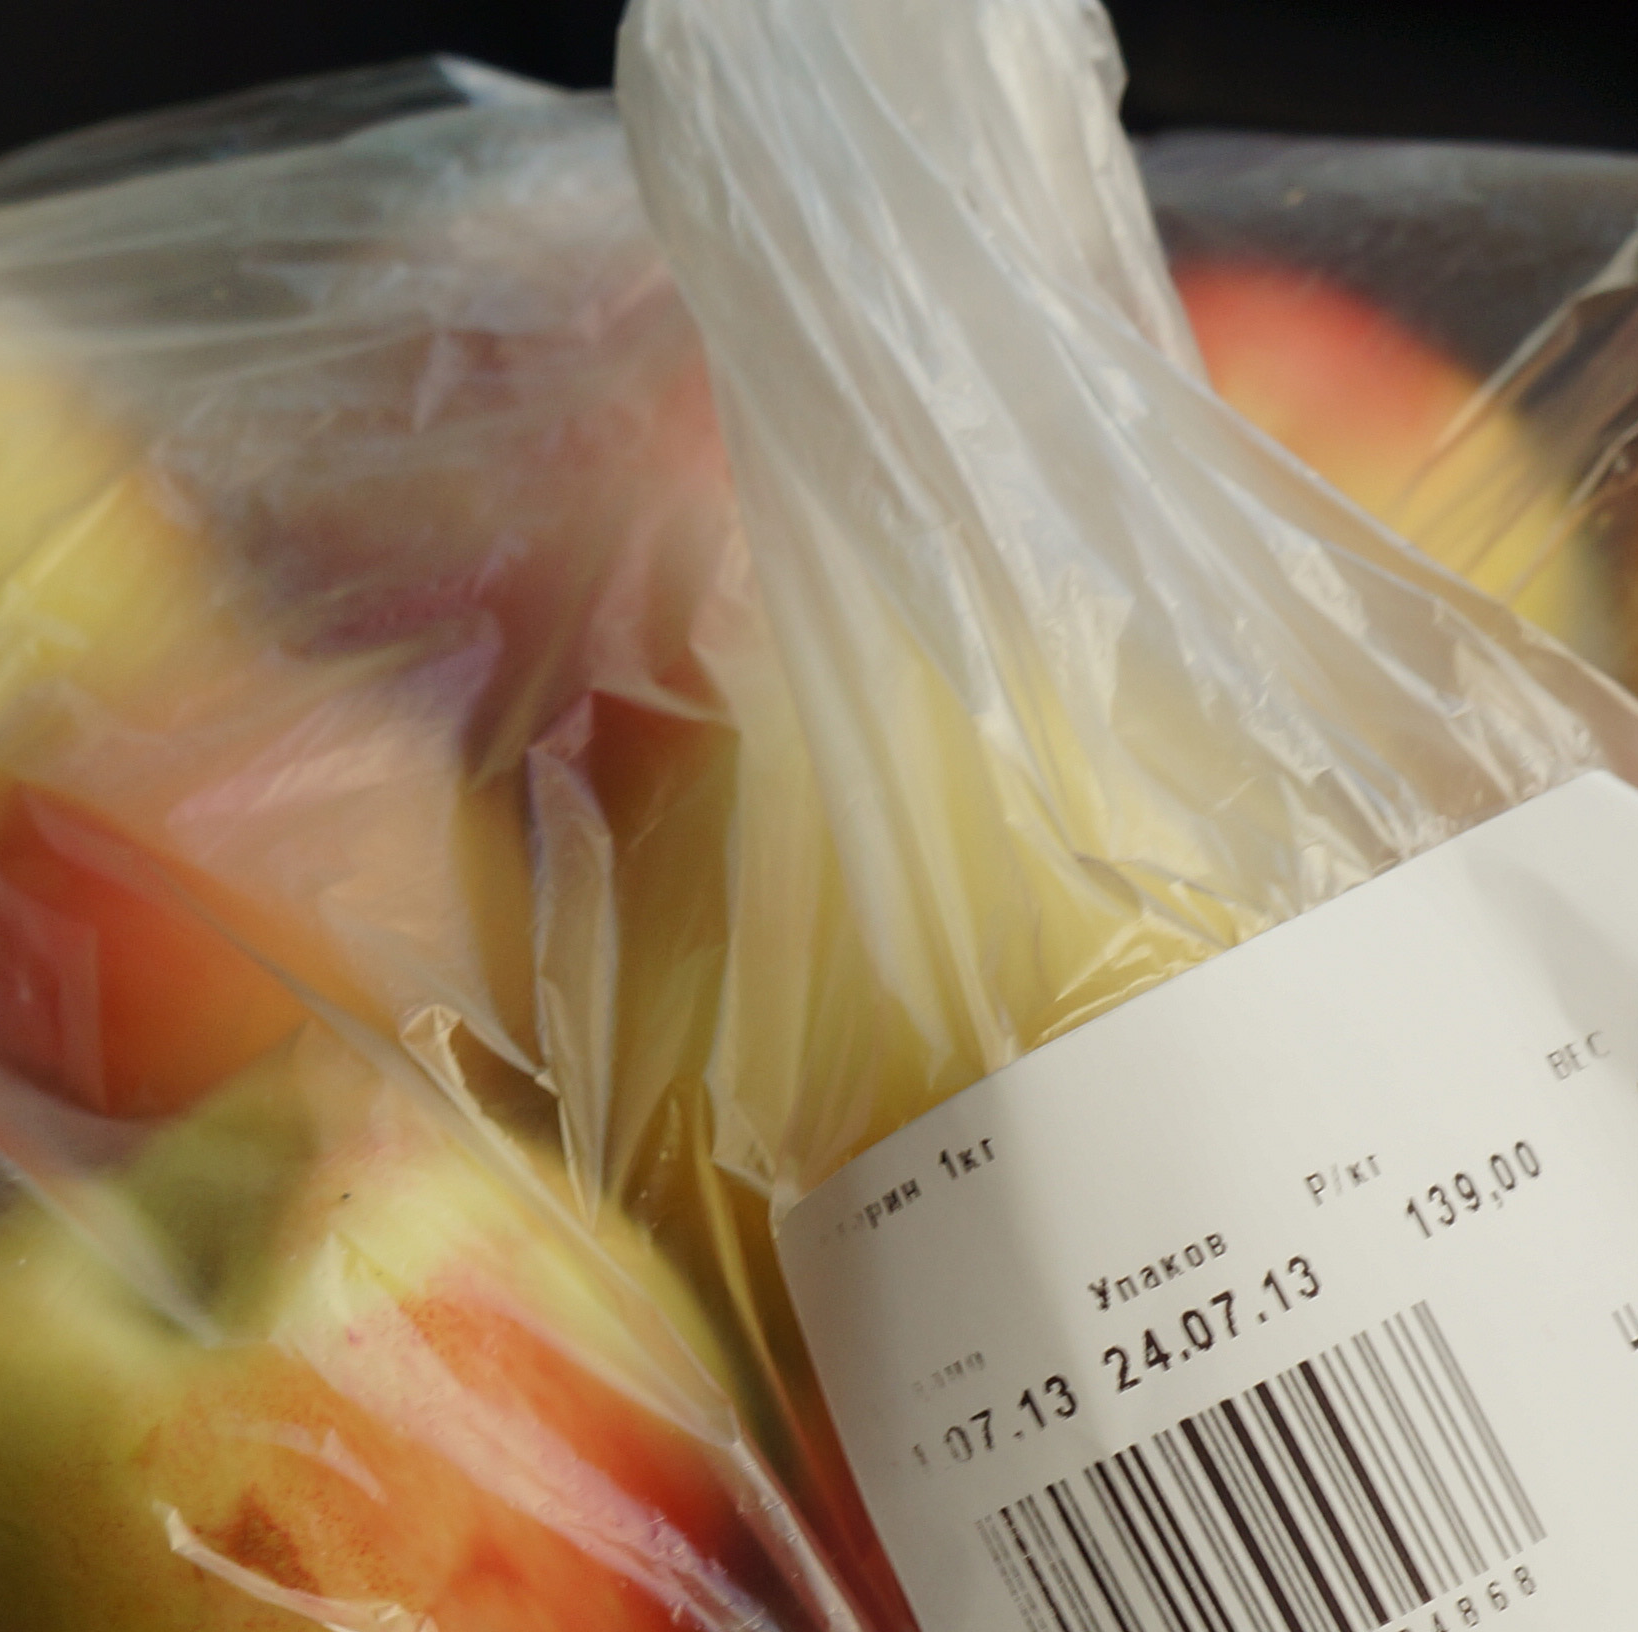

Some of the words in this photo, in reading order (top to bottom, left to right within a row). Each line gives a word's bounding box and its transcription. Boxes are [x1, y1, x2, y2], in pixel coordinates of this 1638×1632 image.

[938, 1136, 996, 1181] 1кг
[1406, 1139, 1543, 1240] 139,00
[1088, 1231, 1230, 1313] Упаков
[1101, 1253, 1324, 1395] 24.07.13
